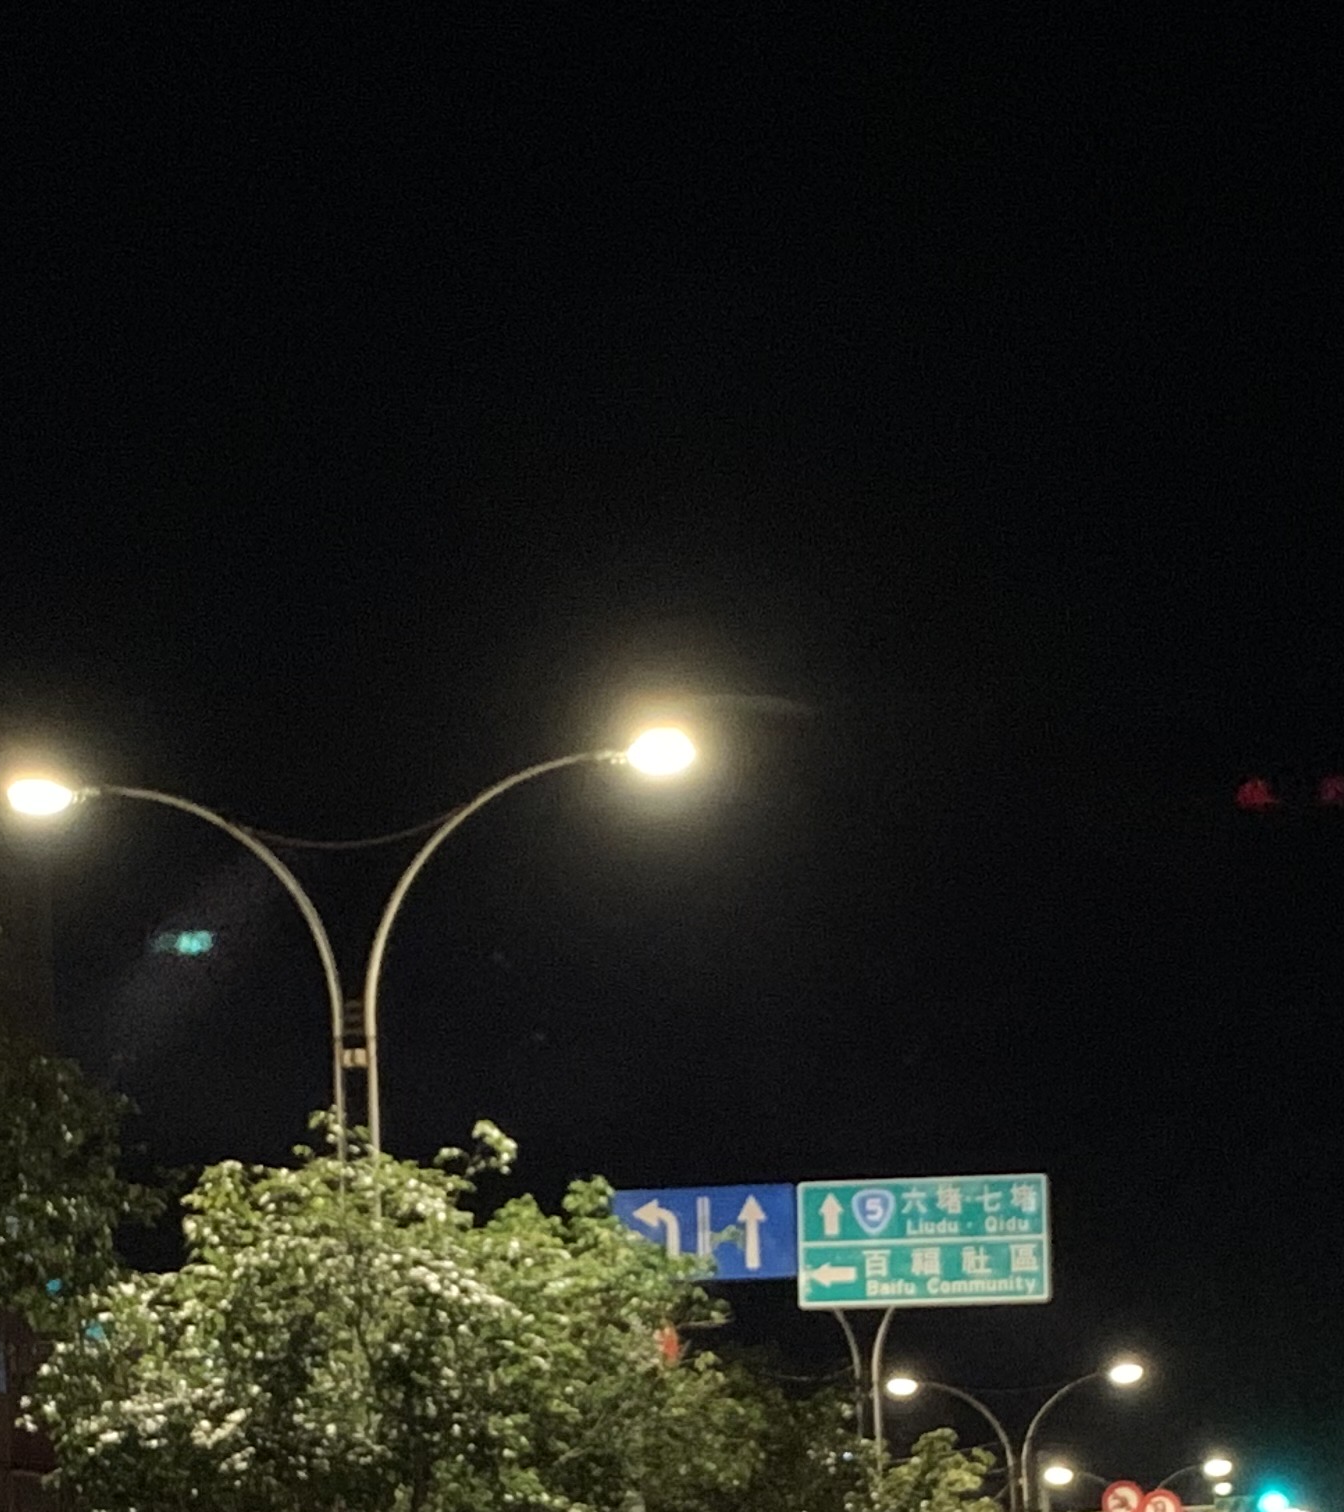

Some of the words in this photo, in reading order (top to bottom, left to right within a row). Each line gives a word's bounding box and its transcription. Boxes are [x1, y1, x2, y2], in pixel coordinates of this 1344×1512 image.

[865, 1197, 884, 1221] 5
[906, 1218, 960, 1235] Liudu
[984, 1215, 1030, 1233] Qidu
[862, 1243, 1039, 1278] 百福社區
[866, 1278, 917, 1297] Baifu
[926, 1275, 1037, 1295] Community
